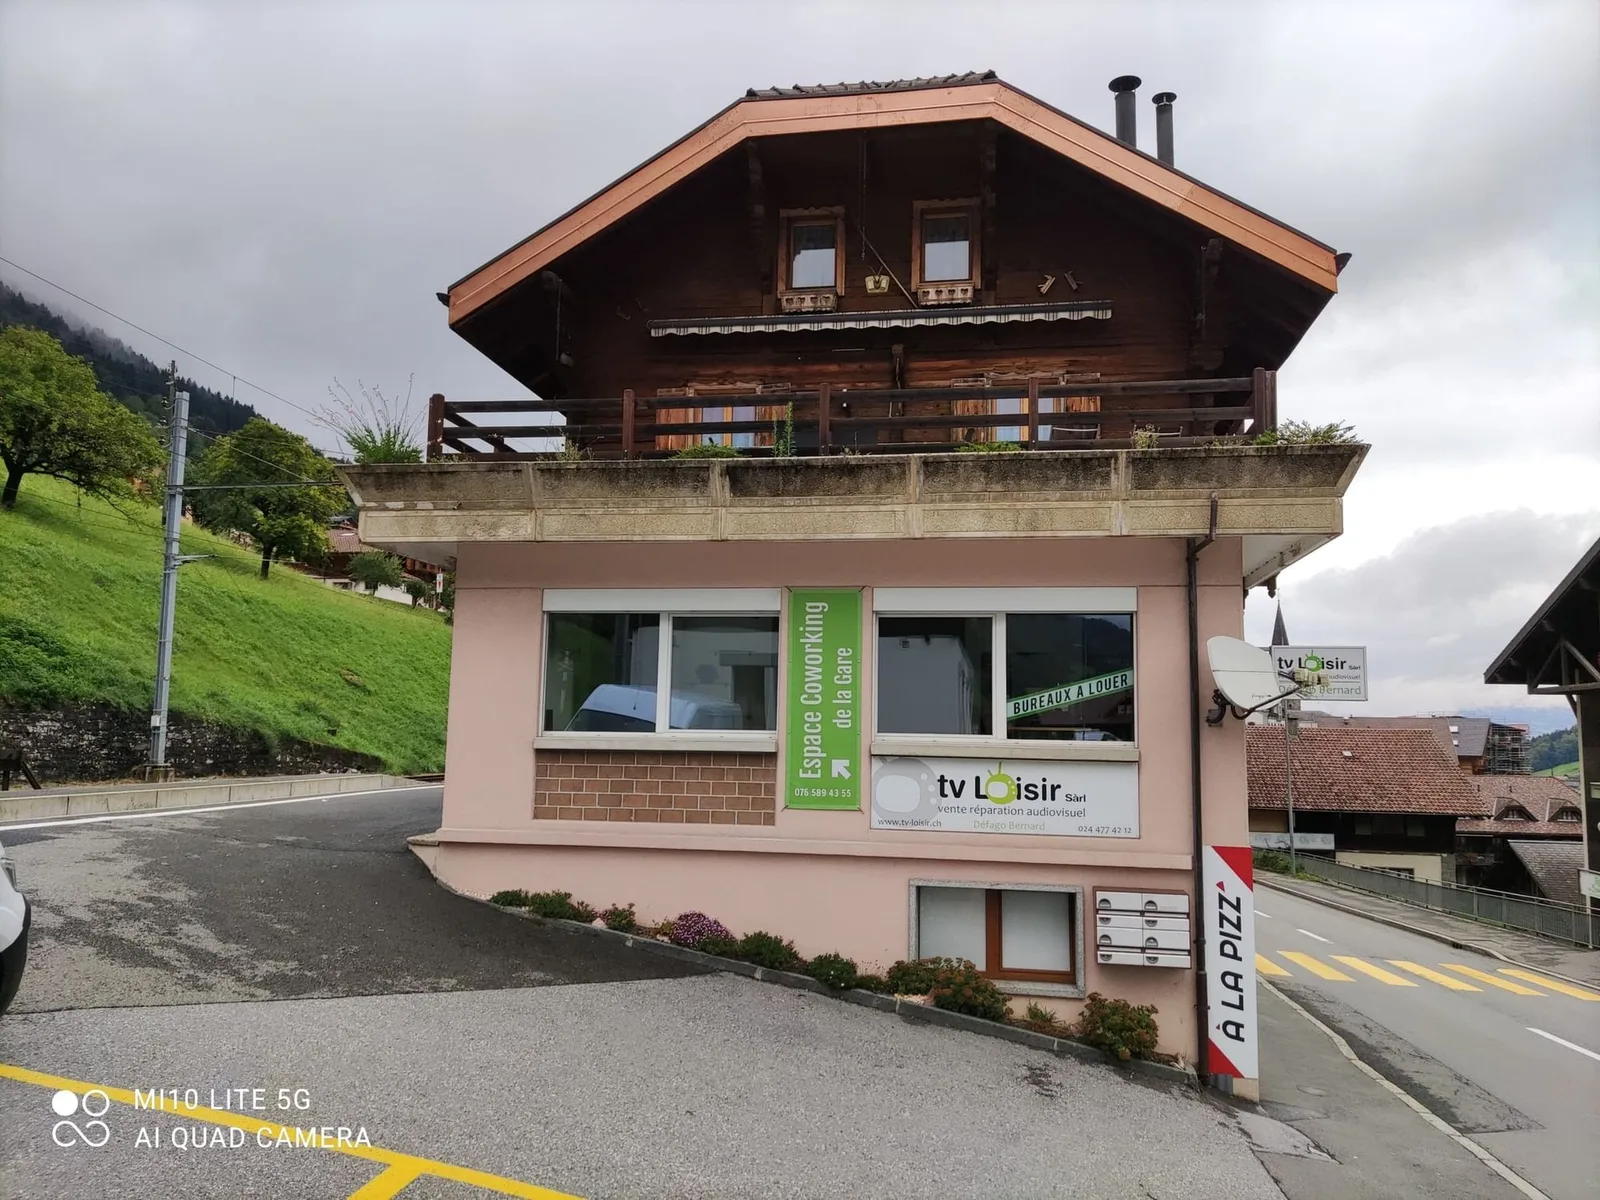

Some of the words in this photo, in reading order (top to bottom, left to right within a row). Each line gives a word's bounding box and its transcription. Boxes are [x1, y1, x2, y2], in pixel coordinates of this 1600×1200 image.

[799, 601, 829, 705] Coworking
[833, 647, 853, 684] Gare
[1277, 656, 1294, 670] tv
[832, 690, 852, 704] la
[1013, 688, 1071, 714] BUREAUX
[1076, 685, 1084, 698] A
[1088, 673, 1128, 695] LOUER
[1319, 685, 1362, 695] Bernard
[832, 709, 852, 729] de
[799, 712, 827, 779] Espace
[794, 788, 809, 796] 076
[811, 788, 826, 797] 589
[828, 788, 839, 798] 43
[841, 789, 852, 798] 55
[937, 773, 966, 798] tv
[974, 773, 1062, 804] Loisir
[1065, 794, 1086, 803] Sàrl
[938, 805, 967, 814] vente
[969, 804, 1024, 816] réparation
[1026, 806, 1086, 818] audiovisuel
[878, 819, 942, 828] www.tv-loisir.ch
[973, 820, 1006, 831] Défago
[1008, 821, 1046, 830] Bernard
[1095, 826, 1110, 834] 477
[1220, 970, 1244, 1011] LA
